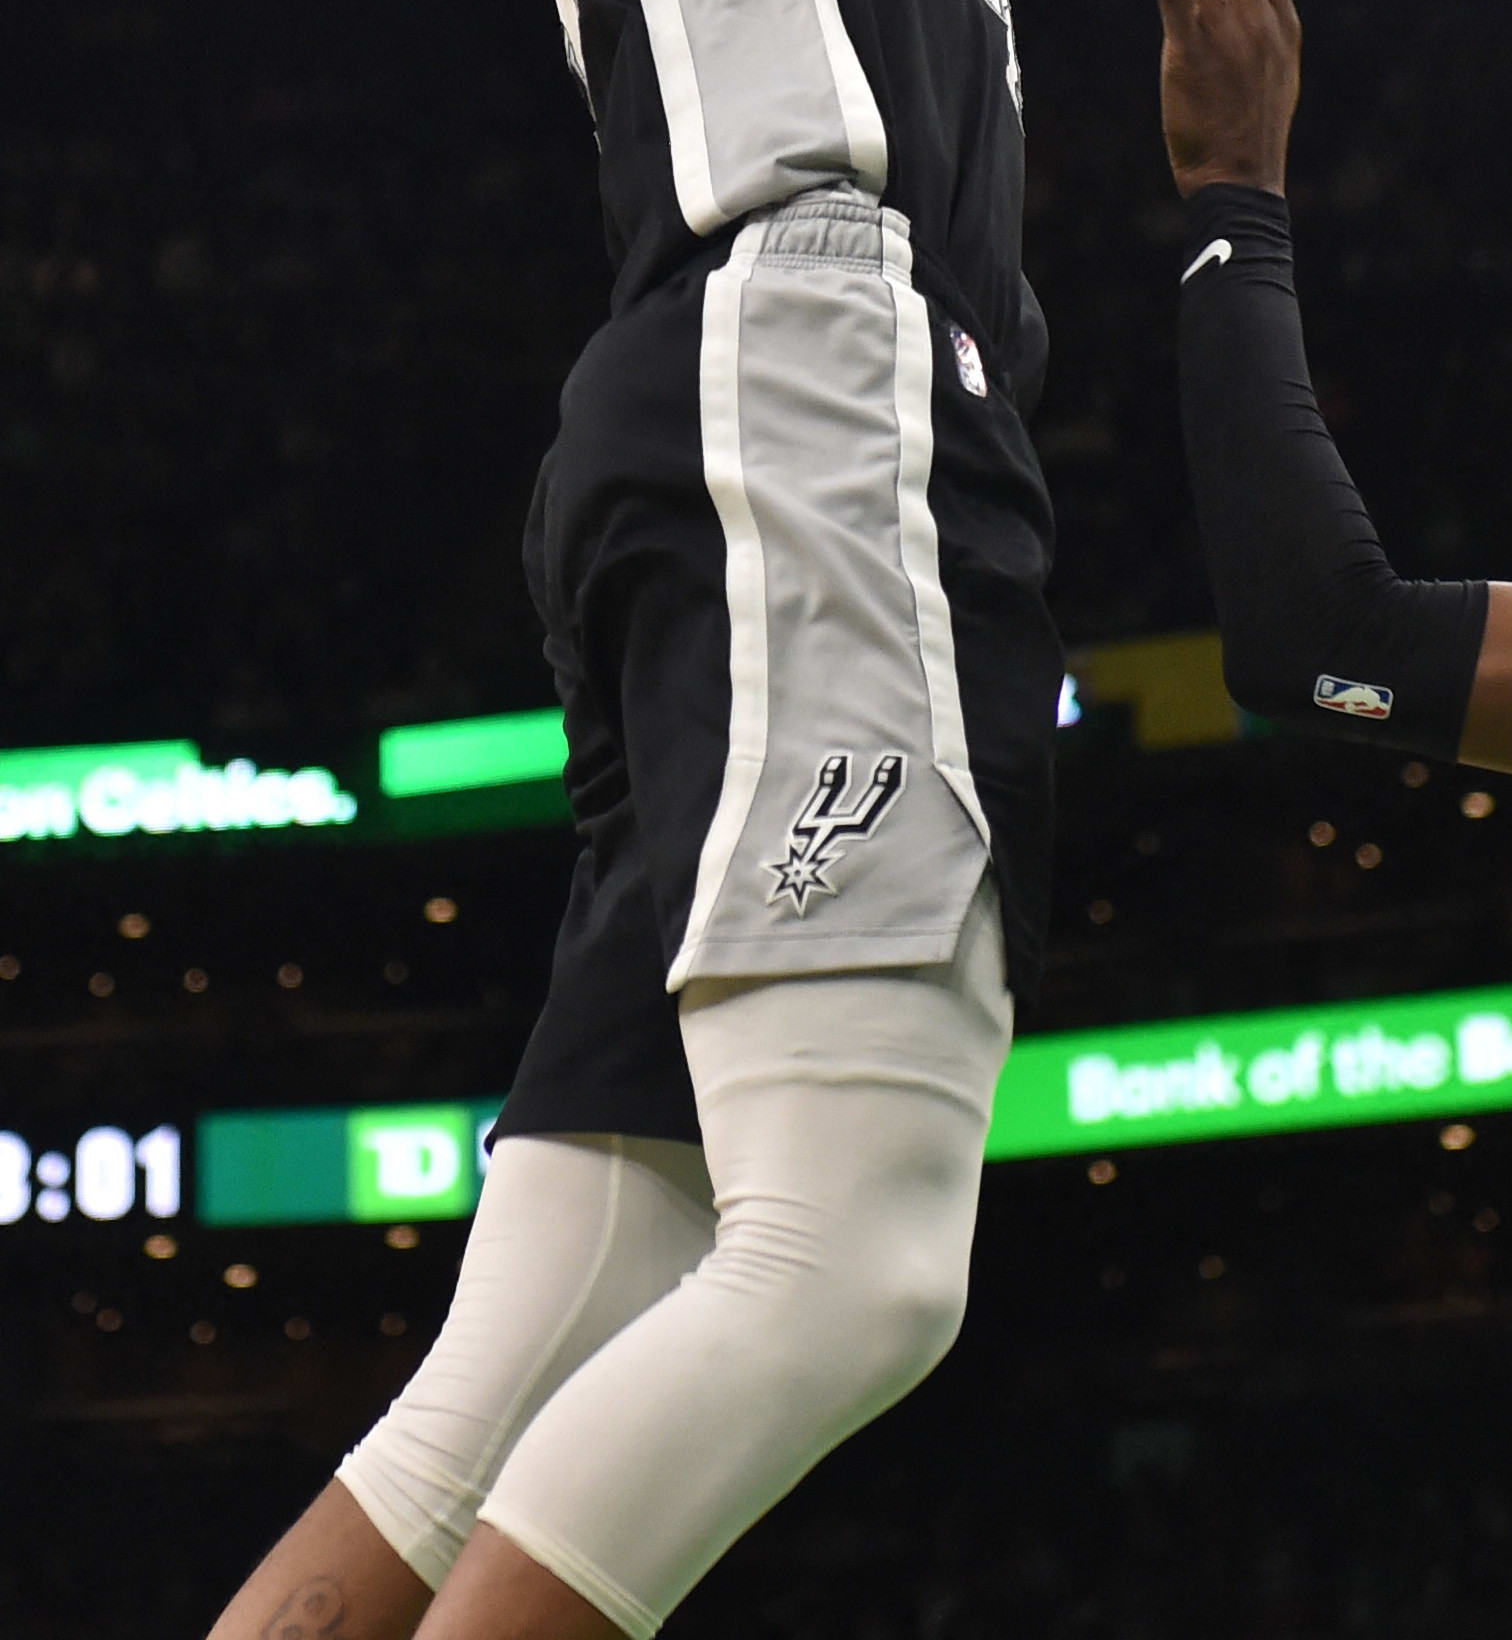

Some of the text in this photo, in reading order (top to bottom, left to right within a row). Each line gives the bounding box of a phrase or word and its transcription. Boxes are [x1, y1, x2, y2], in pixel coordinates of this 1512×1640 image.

[1066, 1040, 1243, 1124] Bank
[1245, 1028, 1326, 1106] of
[1330, 1022, 1453, 1097] the
[362, 1127, 461, 1198] TD
